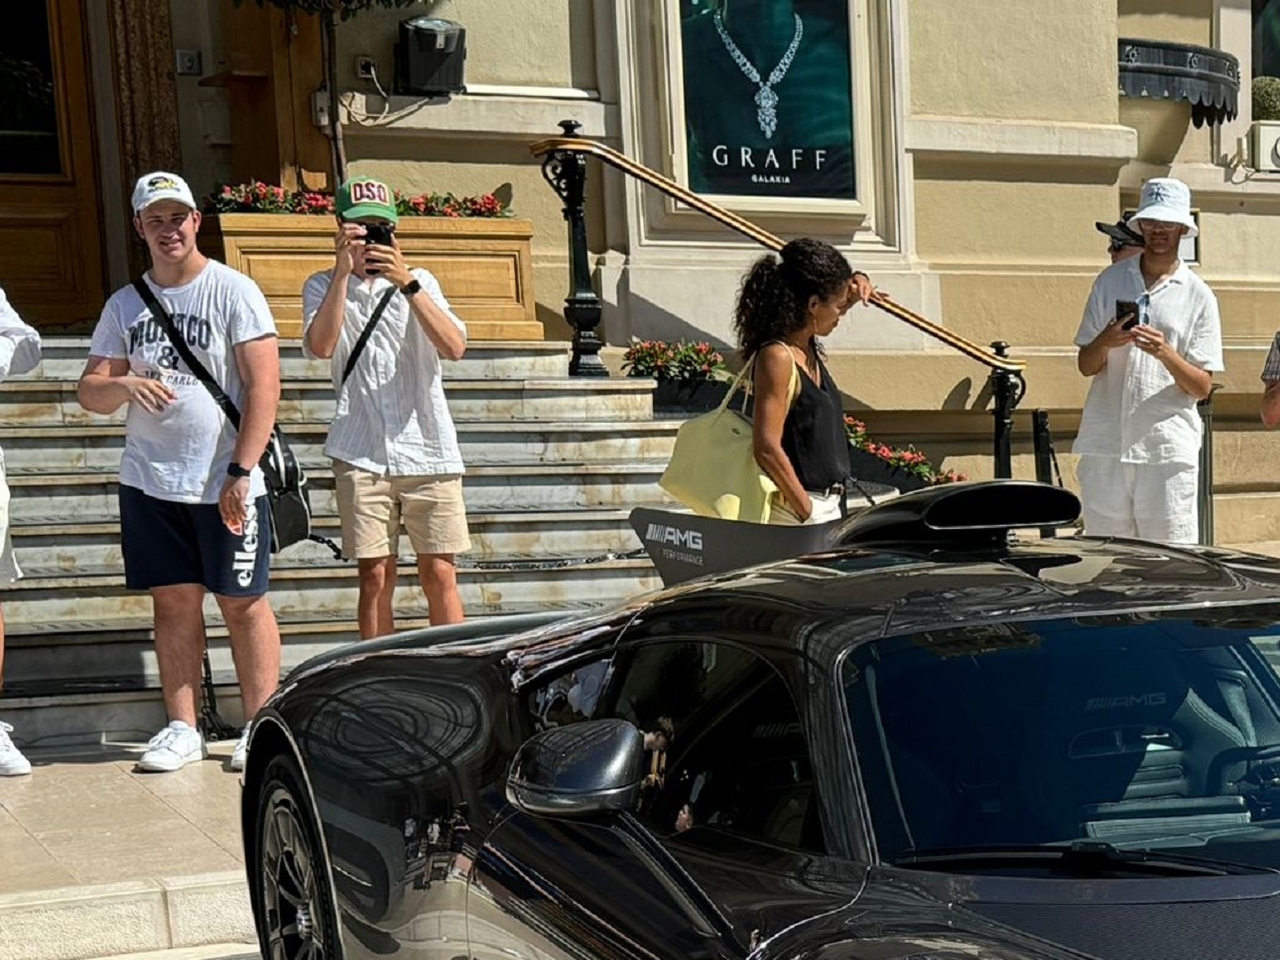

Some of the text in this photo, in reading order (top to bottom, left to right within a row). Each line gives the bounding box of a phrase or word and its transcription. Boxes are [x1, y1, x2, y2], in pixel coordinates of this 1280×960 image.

[712, 145, 827, 170] GRAFF
[751, 174, 790, 184] GALAXIA
[157, 345, 179, 370] &
[166, 374, 199, 386] CARLO
[663, 525, 703, 551] AMG
[1110, 692, 1167, 708] AMG
